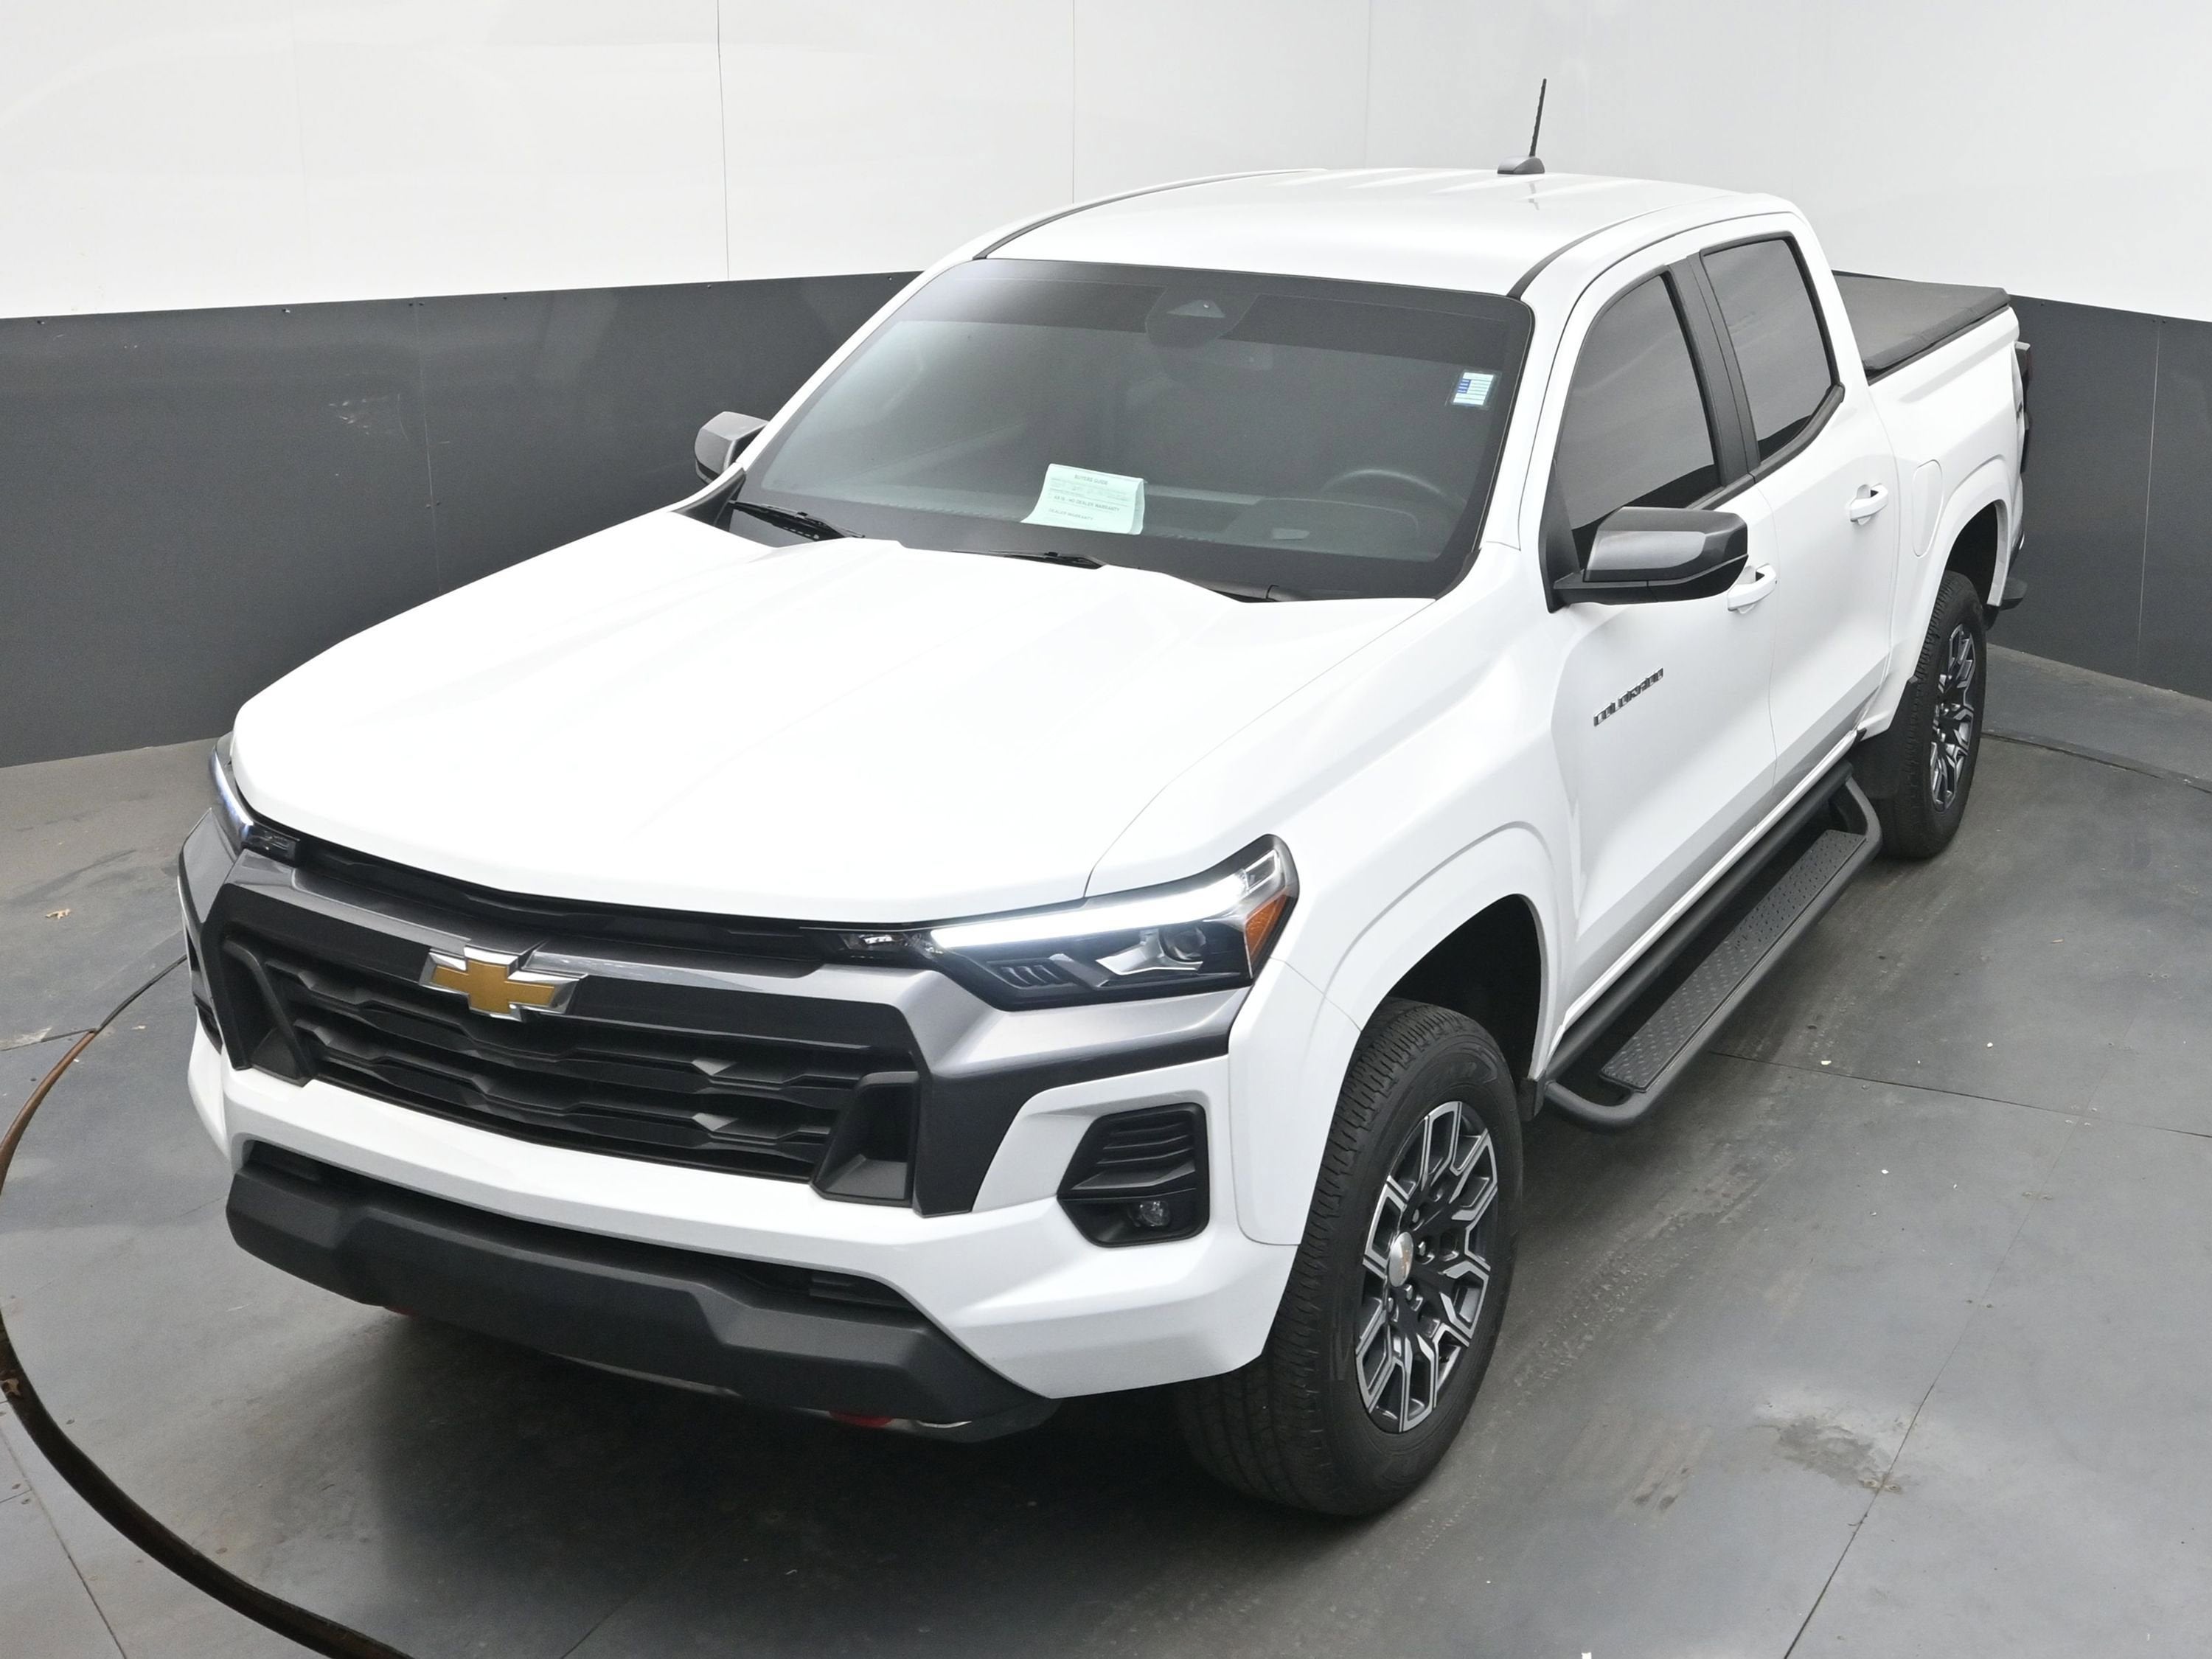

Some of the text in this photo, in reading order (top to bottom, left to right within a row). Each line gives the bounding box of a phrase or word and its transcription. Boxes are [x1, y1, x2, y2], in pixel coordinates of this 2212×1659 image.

[1076, 499, 1094, 507] DEALER
[1095, 503, 1120, 512] WARRANTY
[1593, 667, 1664, 727] COLORADO
